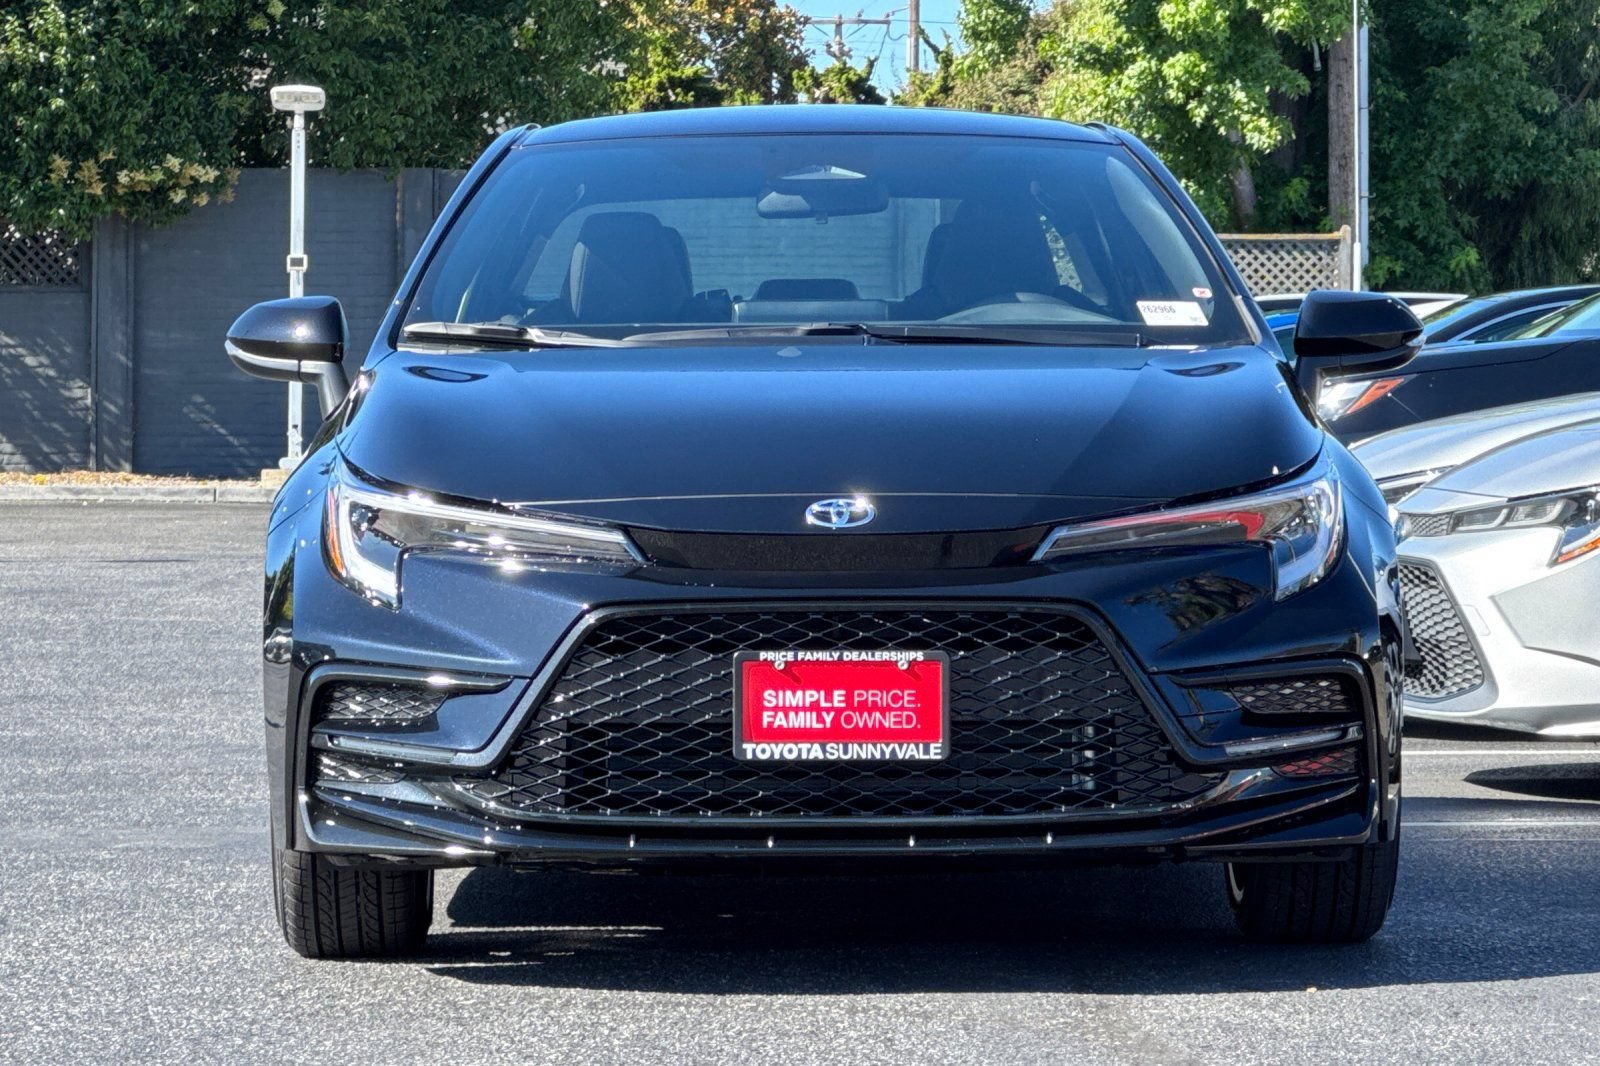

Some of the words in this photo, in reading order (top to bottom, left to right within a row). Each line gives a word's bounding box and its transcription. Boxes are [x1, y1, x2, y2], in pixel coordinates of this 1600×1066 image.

[759, 652, 795, 661] PRICE
[797, 652, 839, 661] FAMILY
[842, 652, 924, 661] DEALERSHIPS
[762, 690, 846, 708] SIMPLE
[853, 690, 921, 708] PRICE.
[762, 711, 835, 728] FAMILY
[840, 711, 921, 729] OWNED.
[742, 743, 824, 760] TOYOTA
[825, 743, 942, 760] SUNNYVALE
